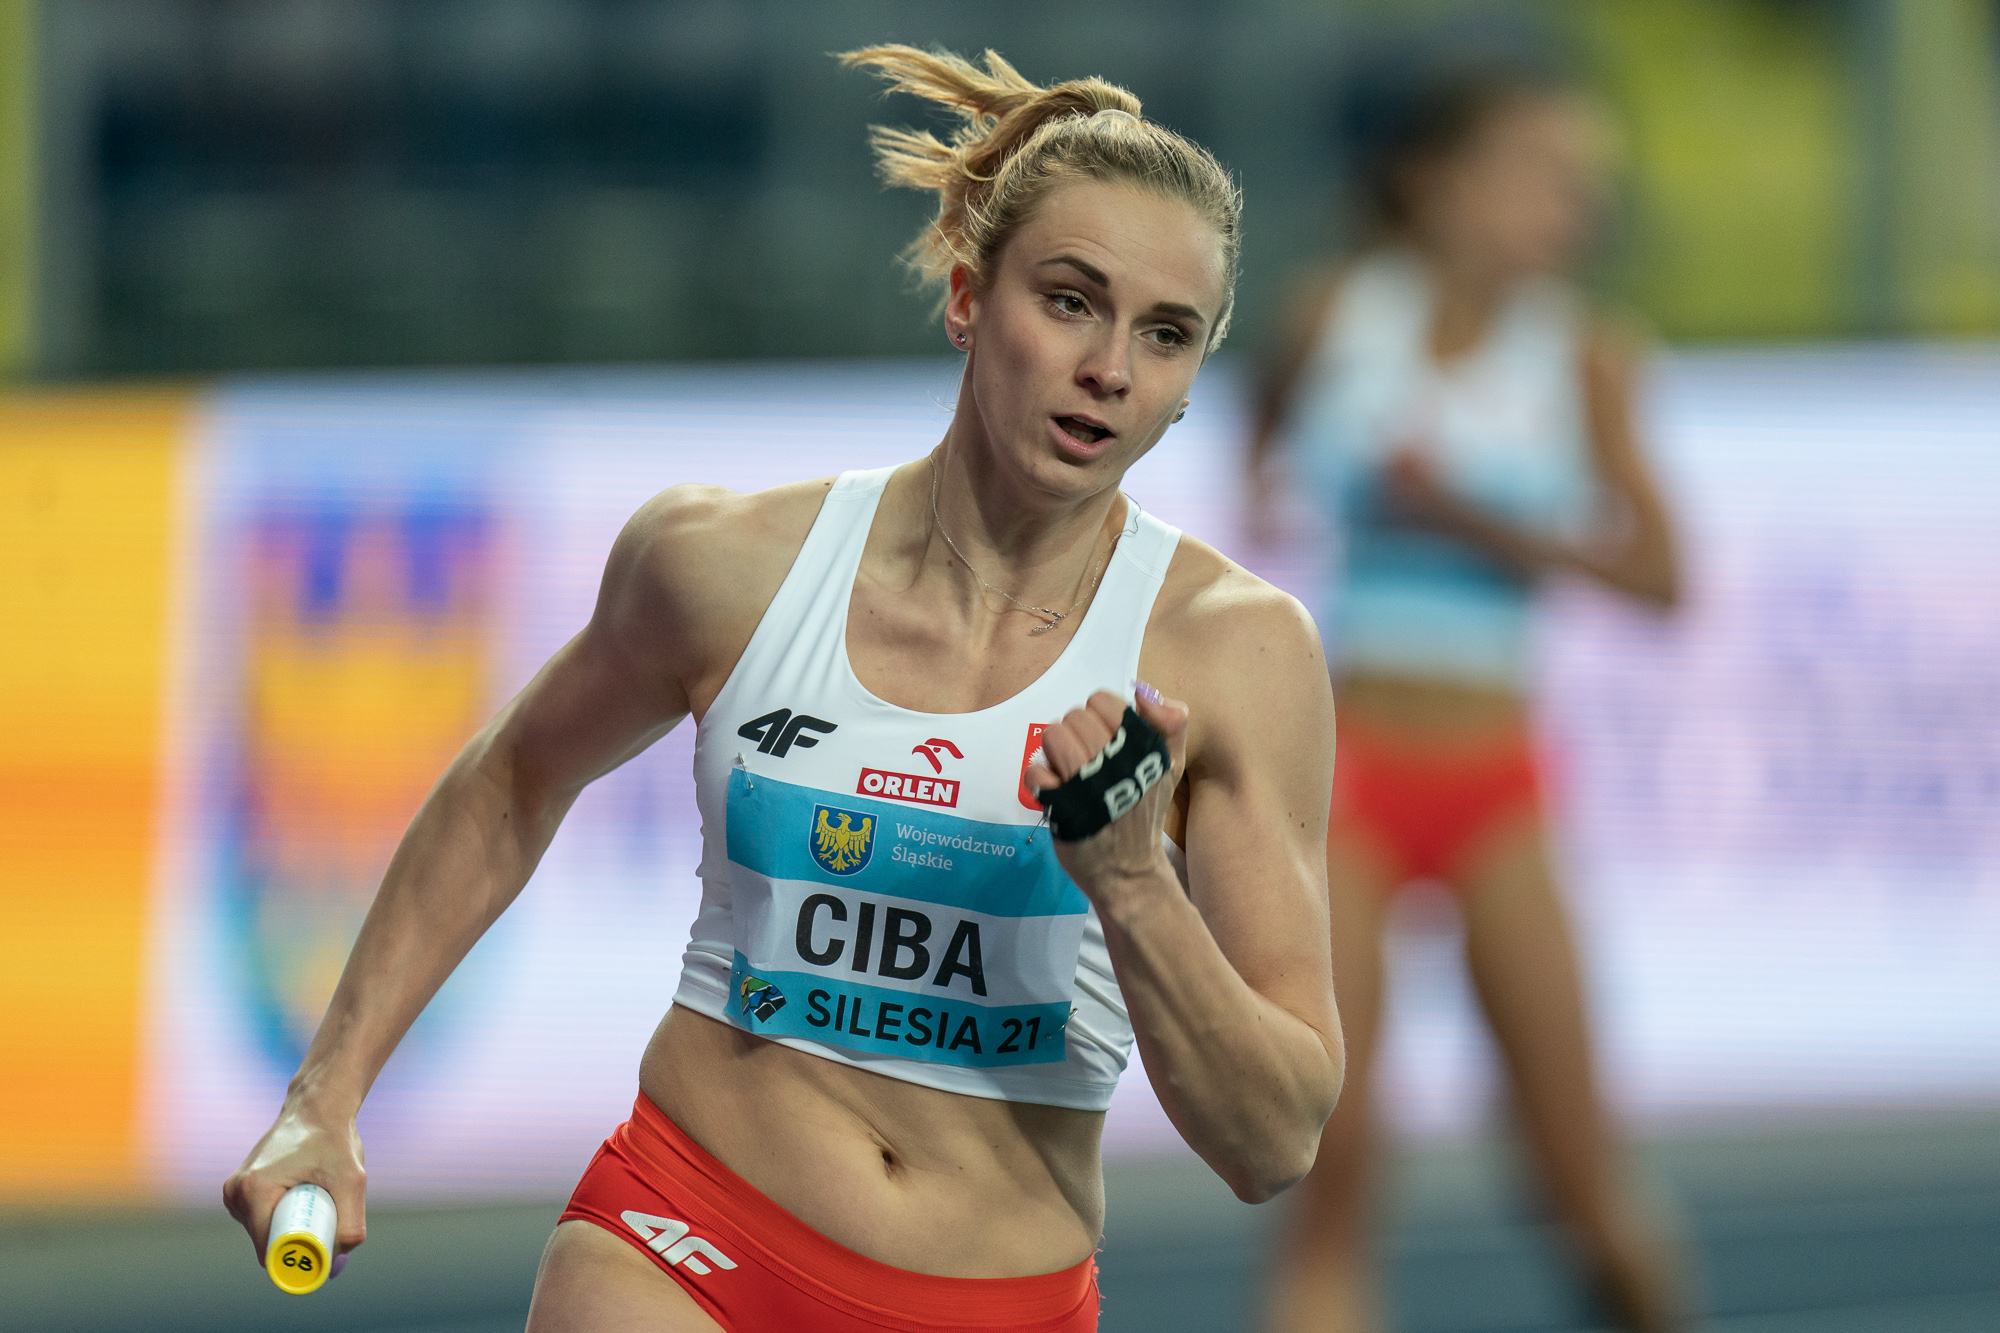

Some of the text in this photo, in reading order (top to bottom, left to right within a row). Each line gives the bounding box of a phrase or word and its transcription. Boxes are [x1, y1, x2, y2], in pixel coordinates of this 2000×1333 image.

[737, 707, 839, 759] 4F
[862, 772, 954, 804] ORLEN
[891, 843, 953, 871] Śląskie
[895, 822, 1016, 858] Województwo
[794, 892, 989, 998] CIBA
[804, 988, 1042, 1055] SILESIA 21
[620, 1209, 739, 1276] 4F
